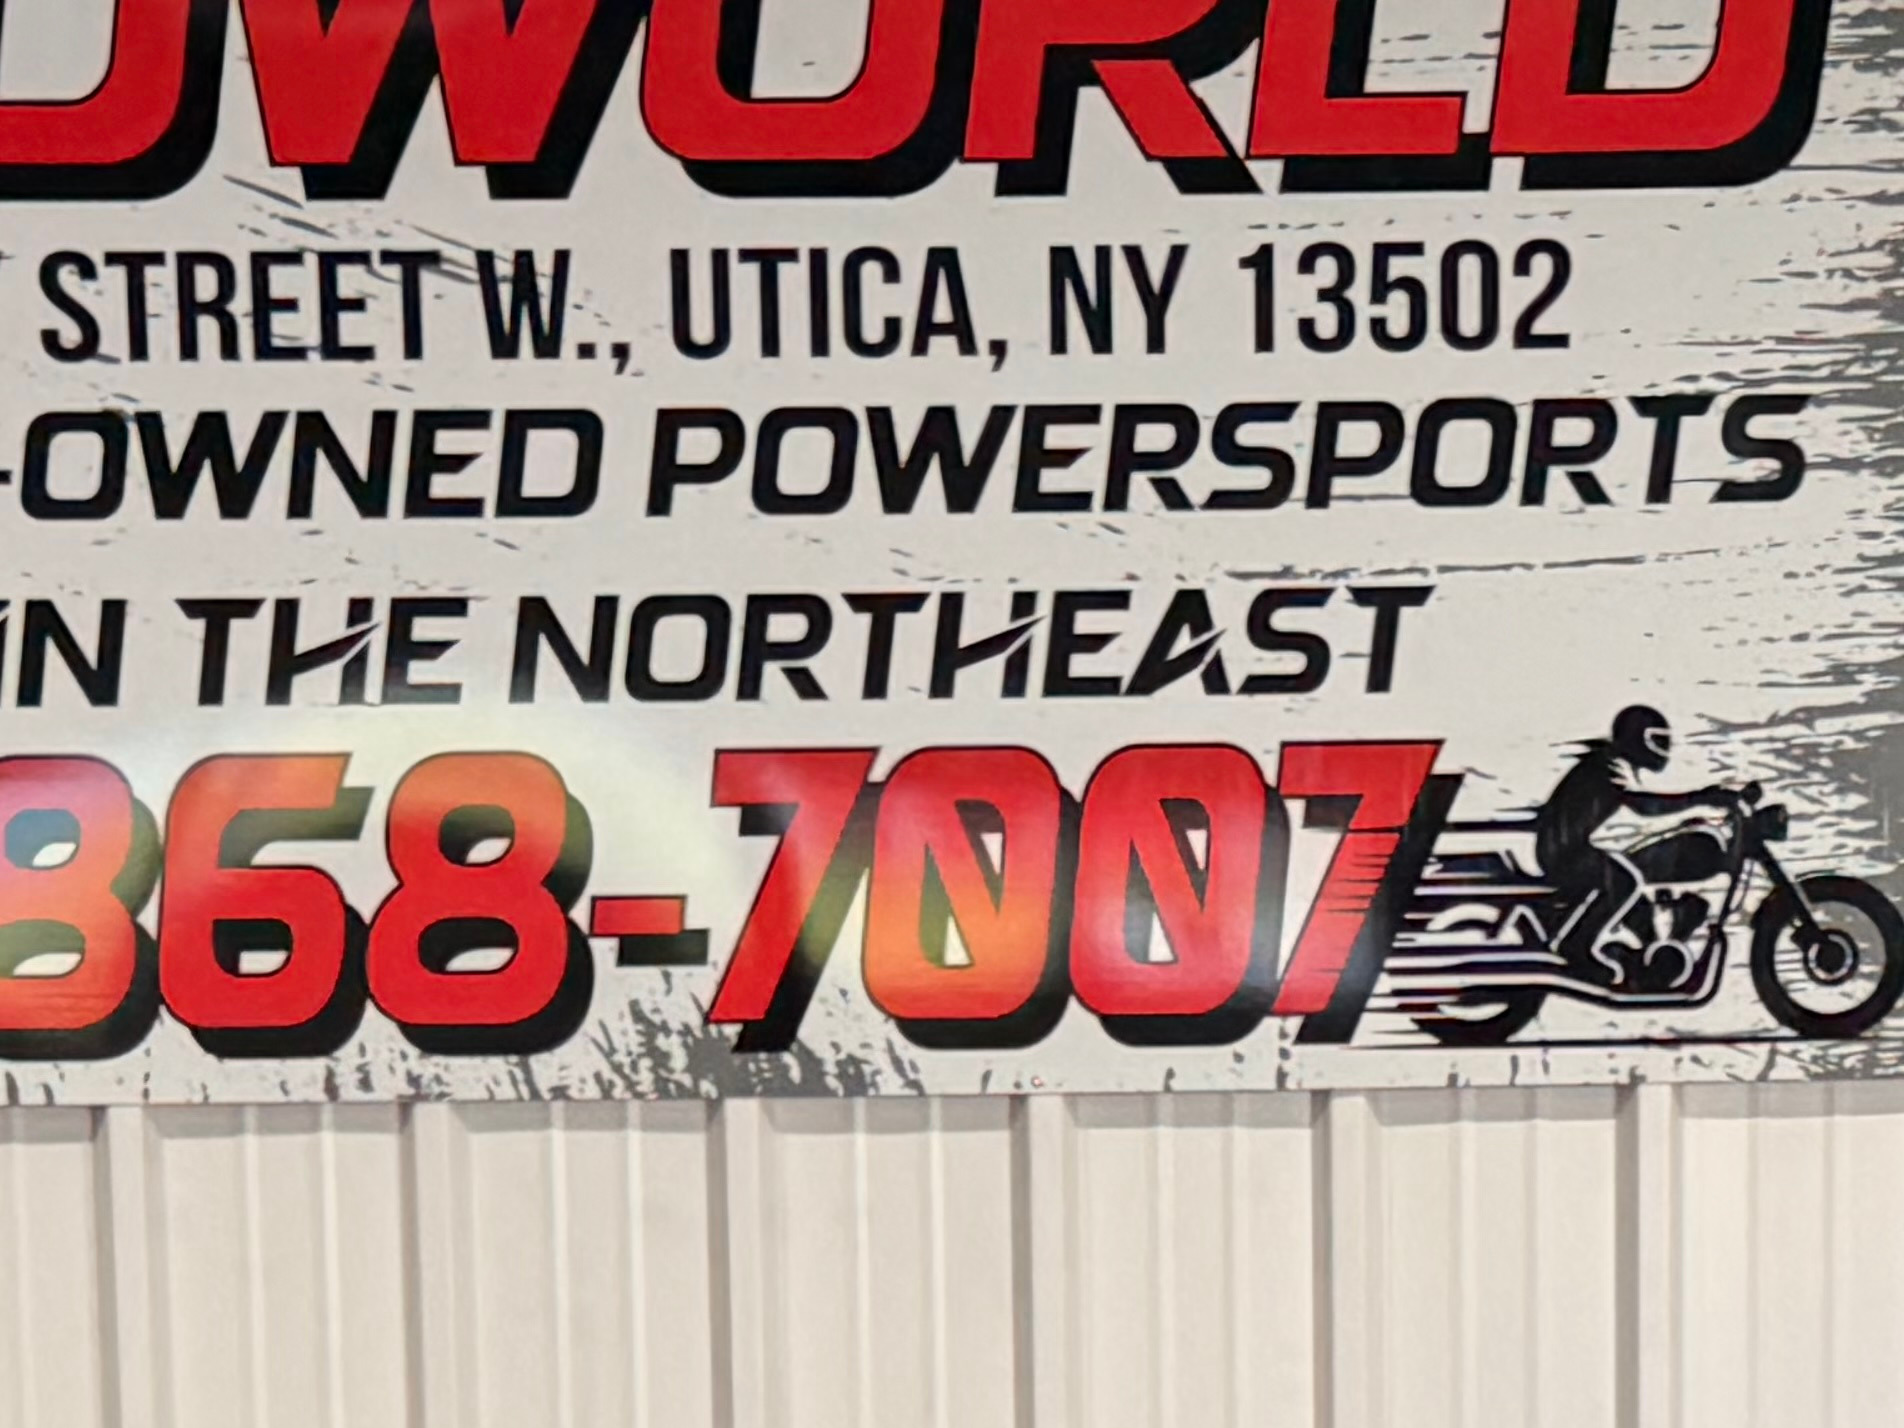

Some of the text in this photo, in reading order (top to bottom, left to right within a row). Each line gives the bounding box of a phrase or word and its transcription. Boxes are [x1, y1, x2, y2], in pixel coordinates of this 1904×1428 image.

[38, 247, 429, 364] STREET
[477, 246, 630, 375] W.,
[669, 244, 1008, 373] UTICA,
[1049, 242, 1189, 356] NY
[1238, 237, 1573, 354] 13502
[646, 391, 1810, 517] POWERSPORTS
[174, 596, 471, 706] THE
[509, 584, 1437, 703] NORTHEAST
